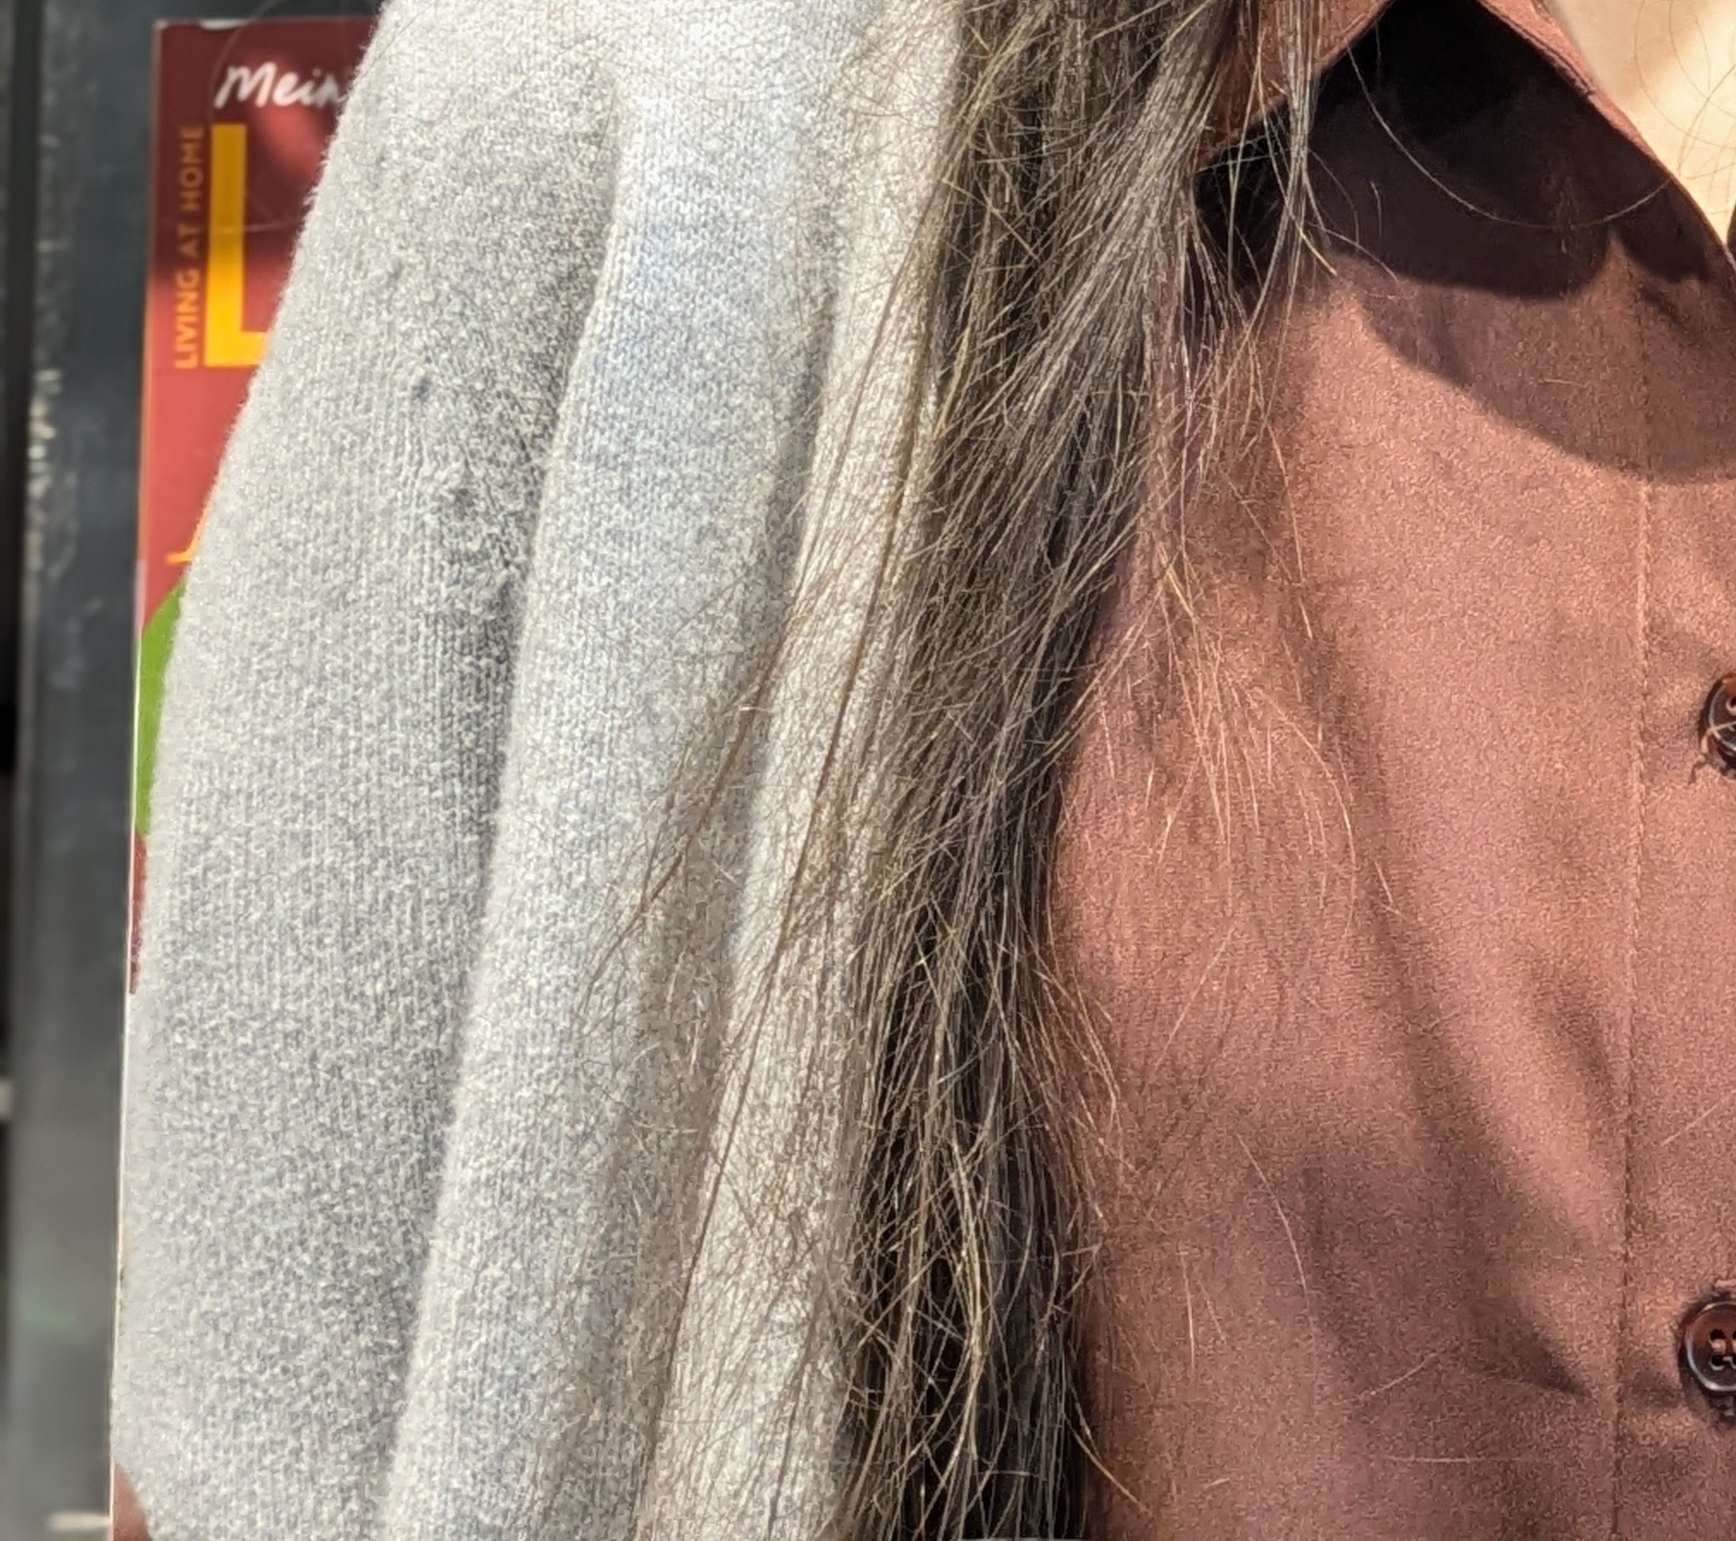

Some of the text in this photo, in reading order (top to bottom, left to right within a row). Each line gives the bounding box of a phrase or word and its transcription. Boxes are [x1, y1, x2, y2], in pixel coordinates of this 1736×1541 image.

[175, 126, 204, 370] LIVING AT HOME
